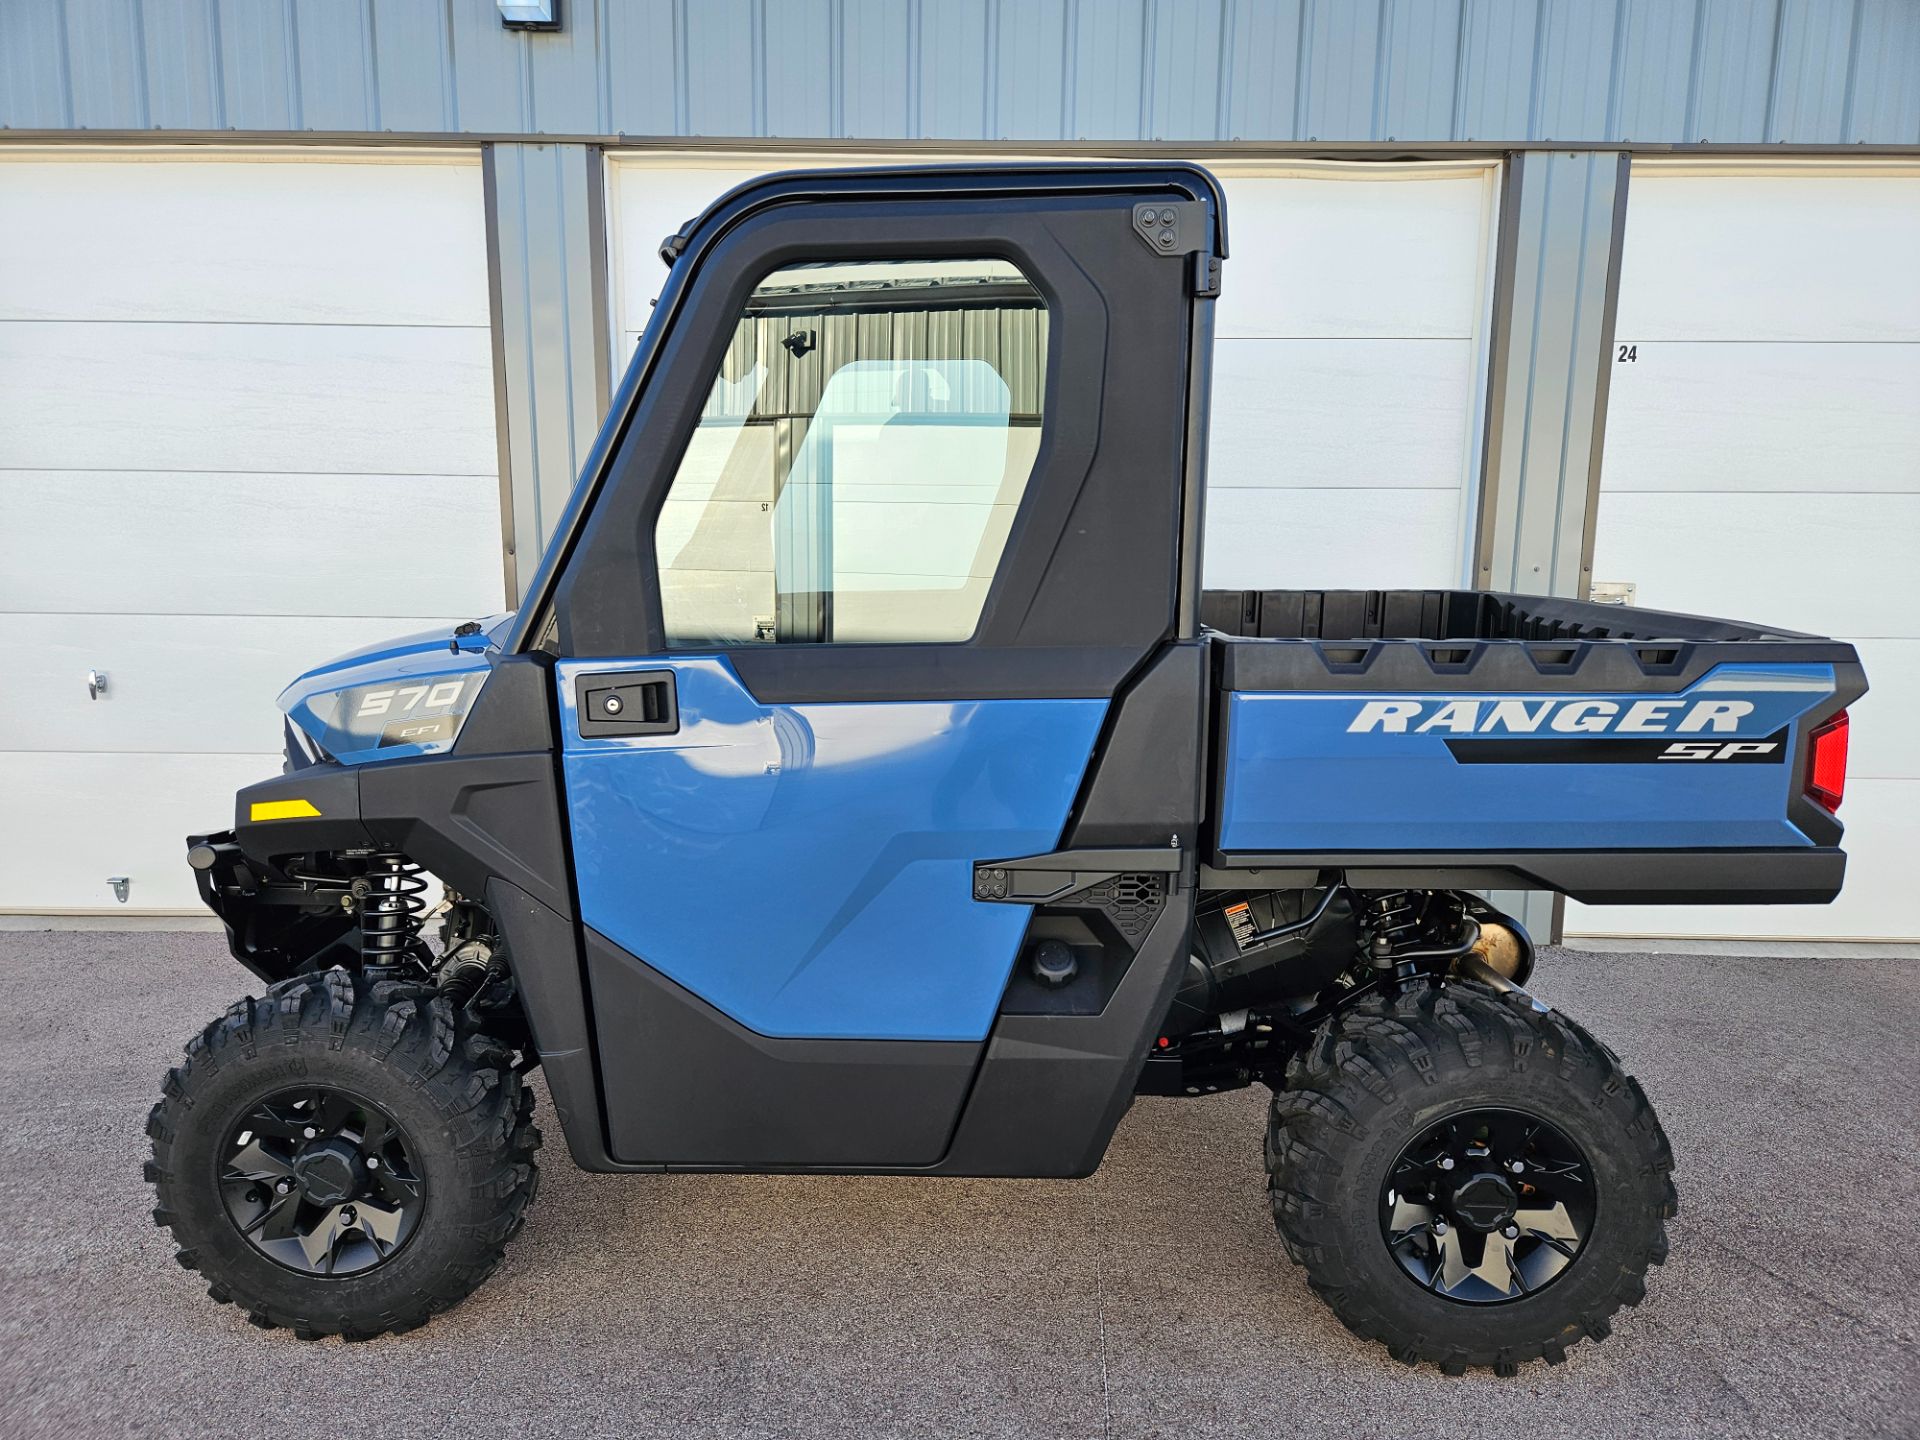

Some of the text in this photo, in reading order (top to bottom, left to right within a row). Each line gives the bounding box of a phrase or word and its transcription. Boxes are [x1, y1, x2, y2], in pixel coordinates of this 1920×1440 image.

[1618, 345, 1637, 363] 24
[357, 681, 465, 717] 570
[1346, 701, 1755, 733] RANGER
[400, 724, 440, 738] EFI
[1657, 742, 1778, 760] SP
